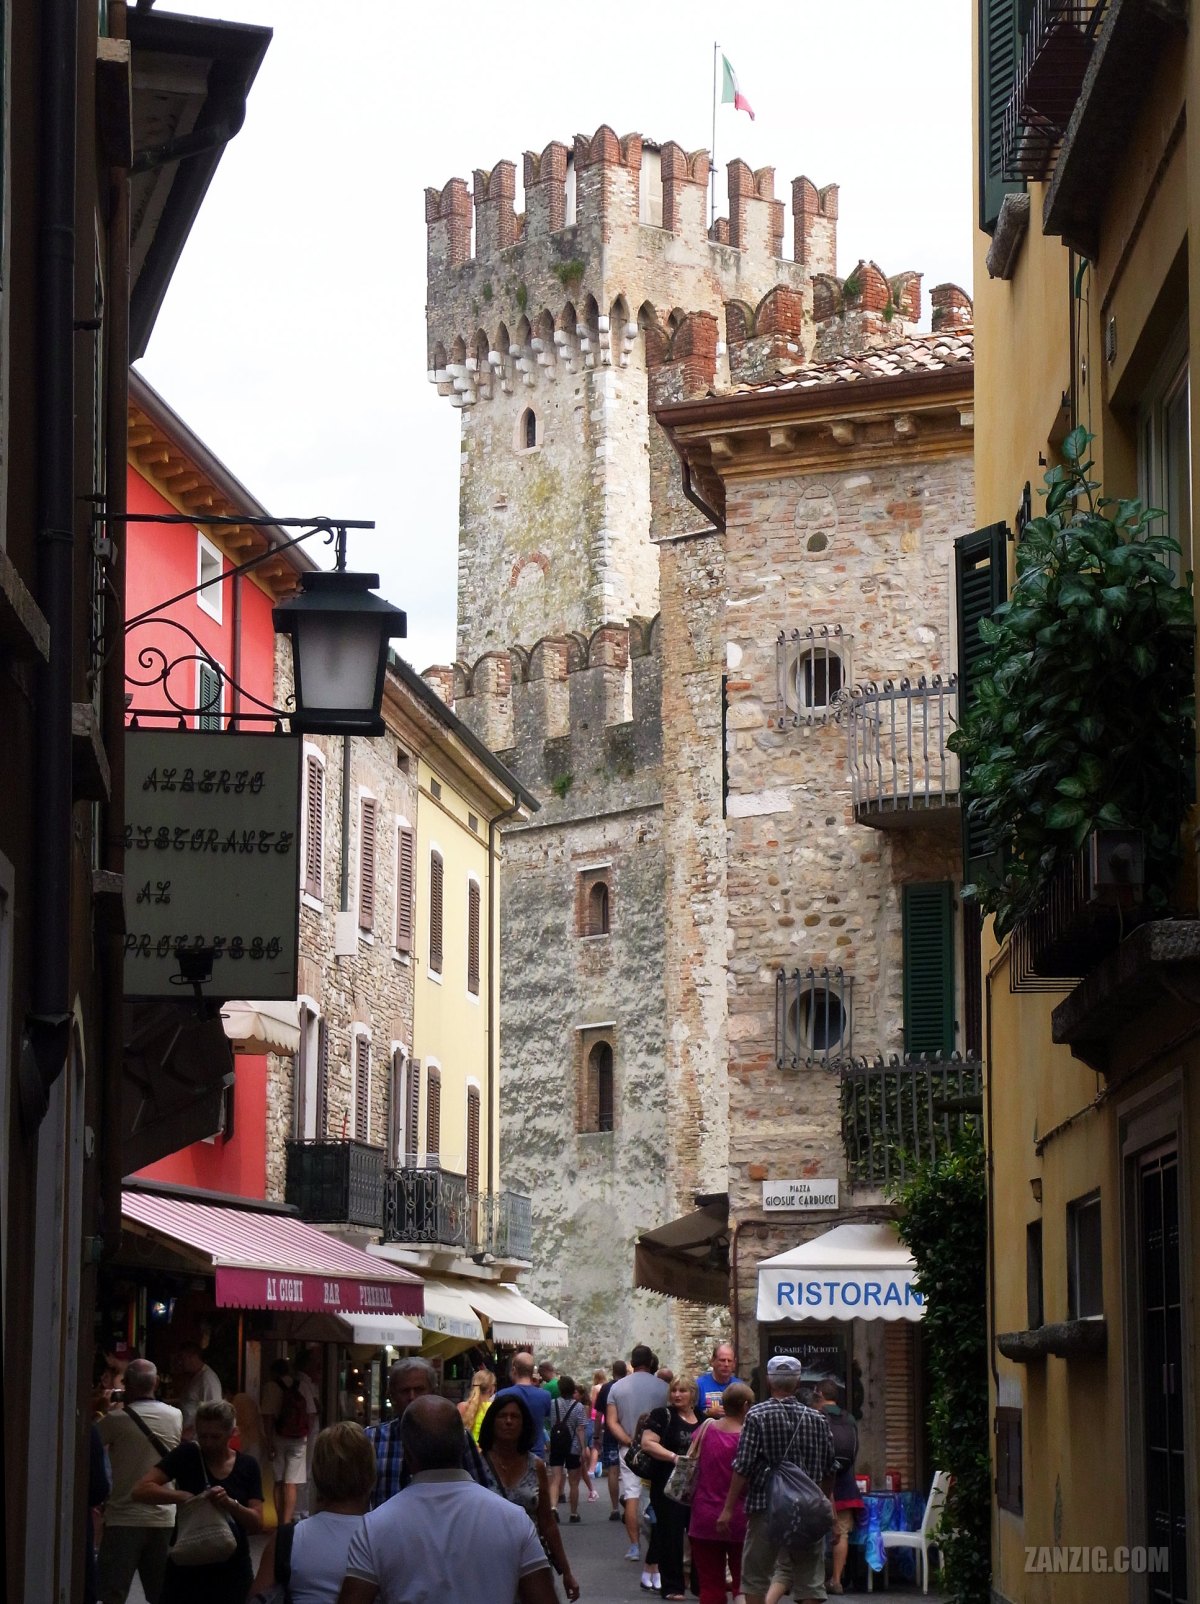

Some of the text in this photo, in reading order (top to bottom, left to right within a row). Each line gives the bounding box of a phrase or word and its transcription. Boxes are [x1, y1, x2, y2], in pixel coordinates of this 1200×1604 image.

[143, 767, 265, 794] ALBERGO
[136, 880, 171, 904] AL
[789, 1184, 811, 1193] PIAZZA
[798, 1194, 836, 1205] CARDUCCI
[279, 1279, 304, 1302] CIGNI
[324, 1282, 341, 1305] BAR
[777, 1281, 924, 1306] RISTORAN
